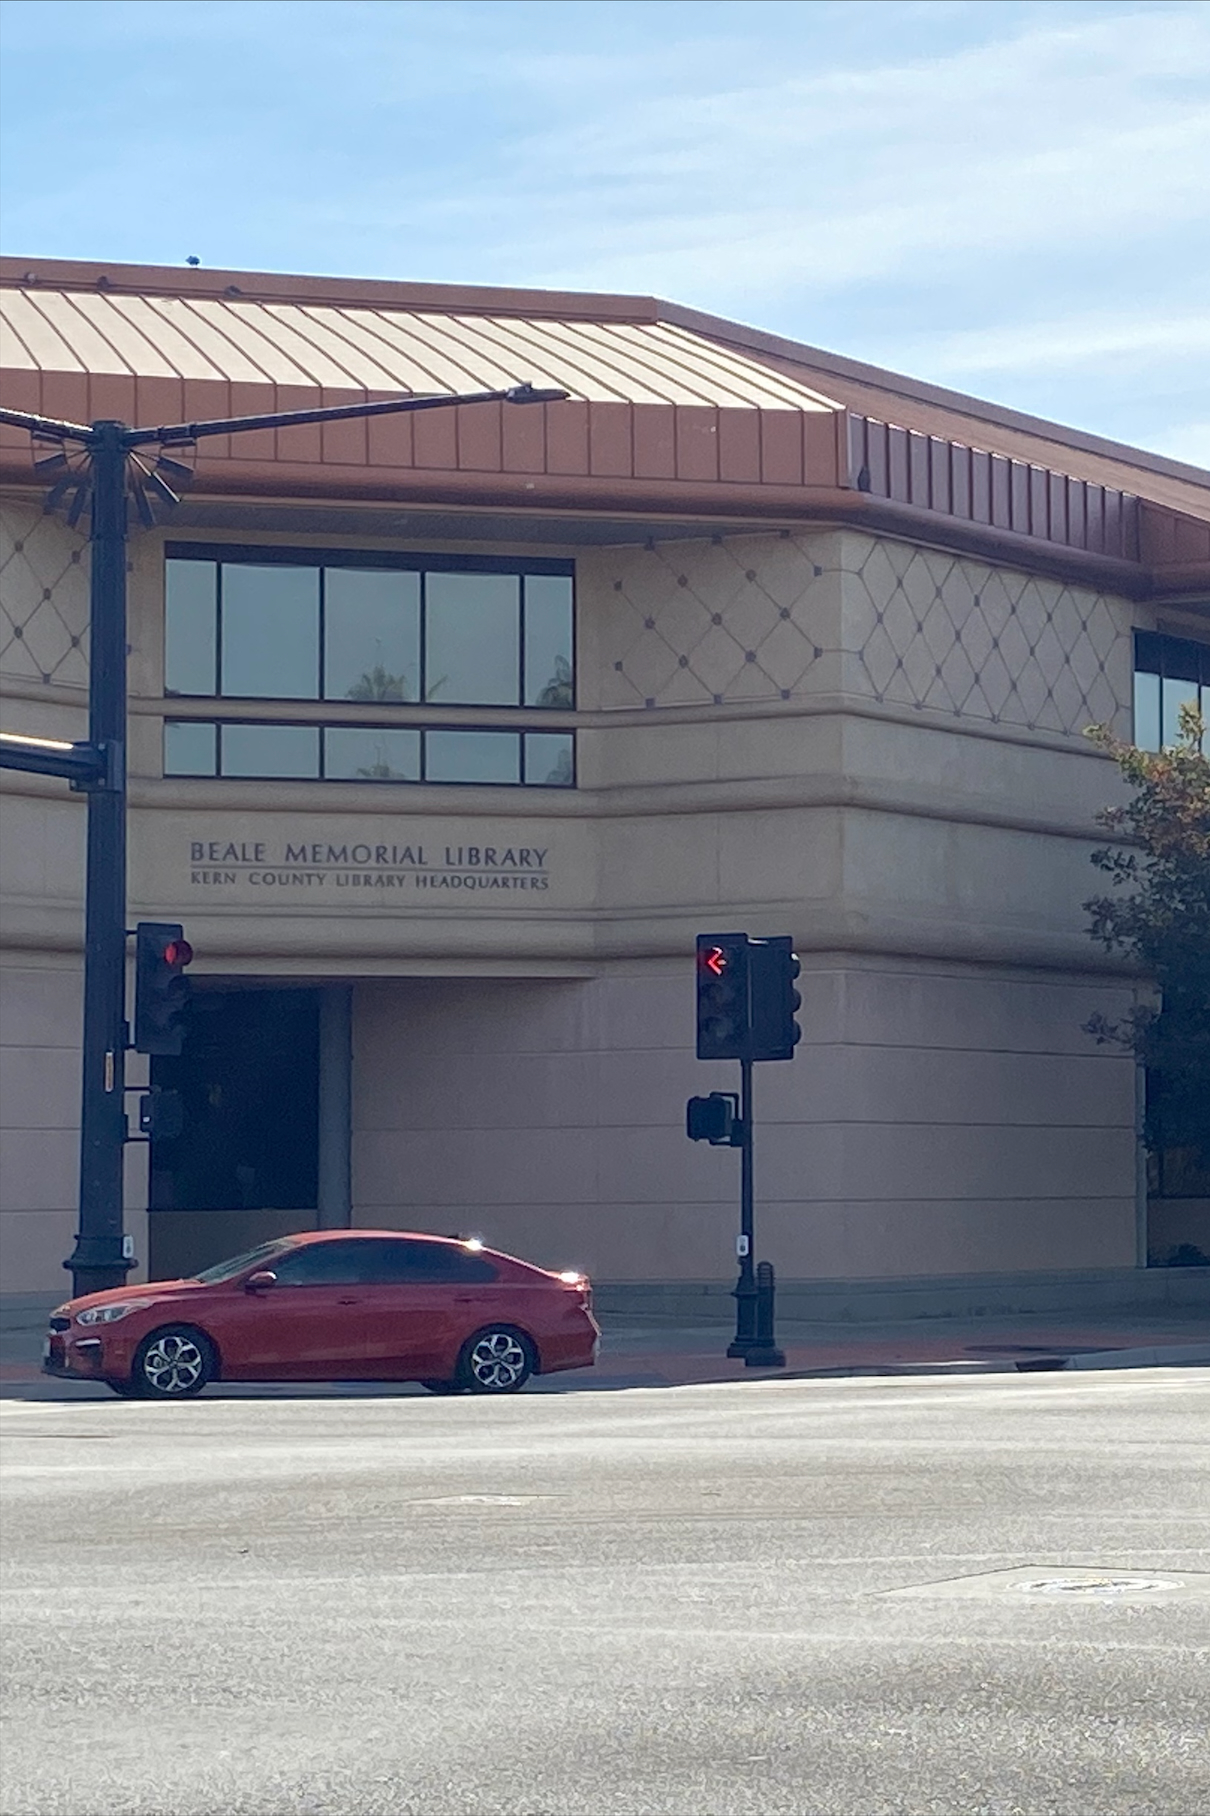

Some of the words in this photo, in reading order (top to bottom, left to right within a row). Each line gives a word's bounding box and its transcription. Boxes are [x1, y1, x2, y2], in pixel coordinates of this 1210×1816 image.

[190, 842, 266, 862] BEALE
[285, 843, 428, 865] MEMORIAL
[445, 847, 548, 867] LIBRARY
[191, 871, 236, 884] KERN
[249, 872, 325, 887] COUNTY
[336, 874, 405, 888] LIBRARY
[416, 875, 549, 890] HEADQUARTERS
